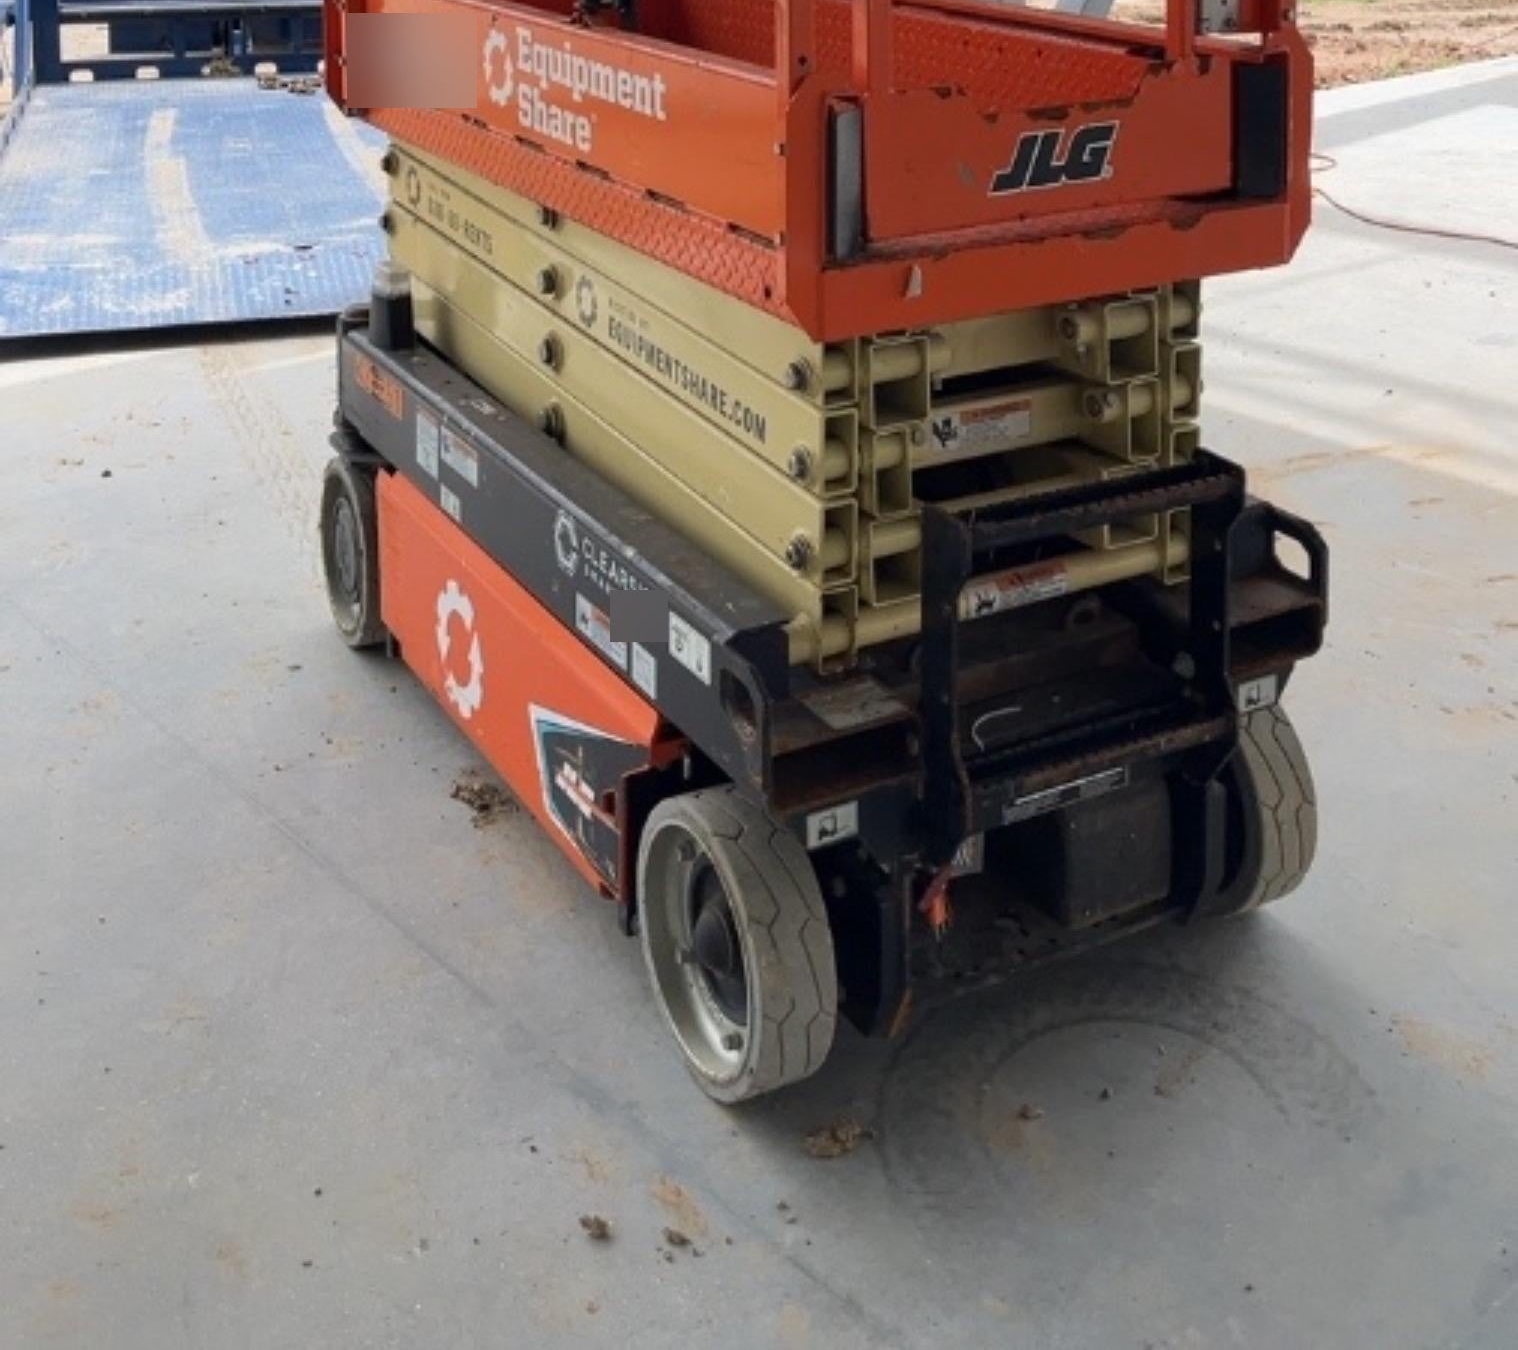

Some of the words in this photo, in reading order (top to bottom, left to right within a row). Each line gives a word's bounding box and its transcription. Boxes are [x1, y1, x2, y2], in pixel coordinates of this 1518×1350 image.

[516, 26, 667, 122] Equipment
[518, 82, 593, 152] Share
[987, 119, 1119, 197] JLG
[607, 314, 767, 444] EQUIPMENTSHARE.COM
